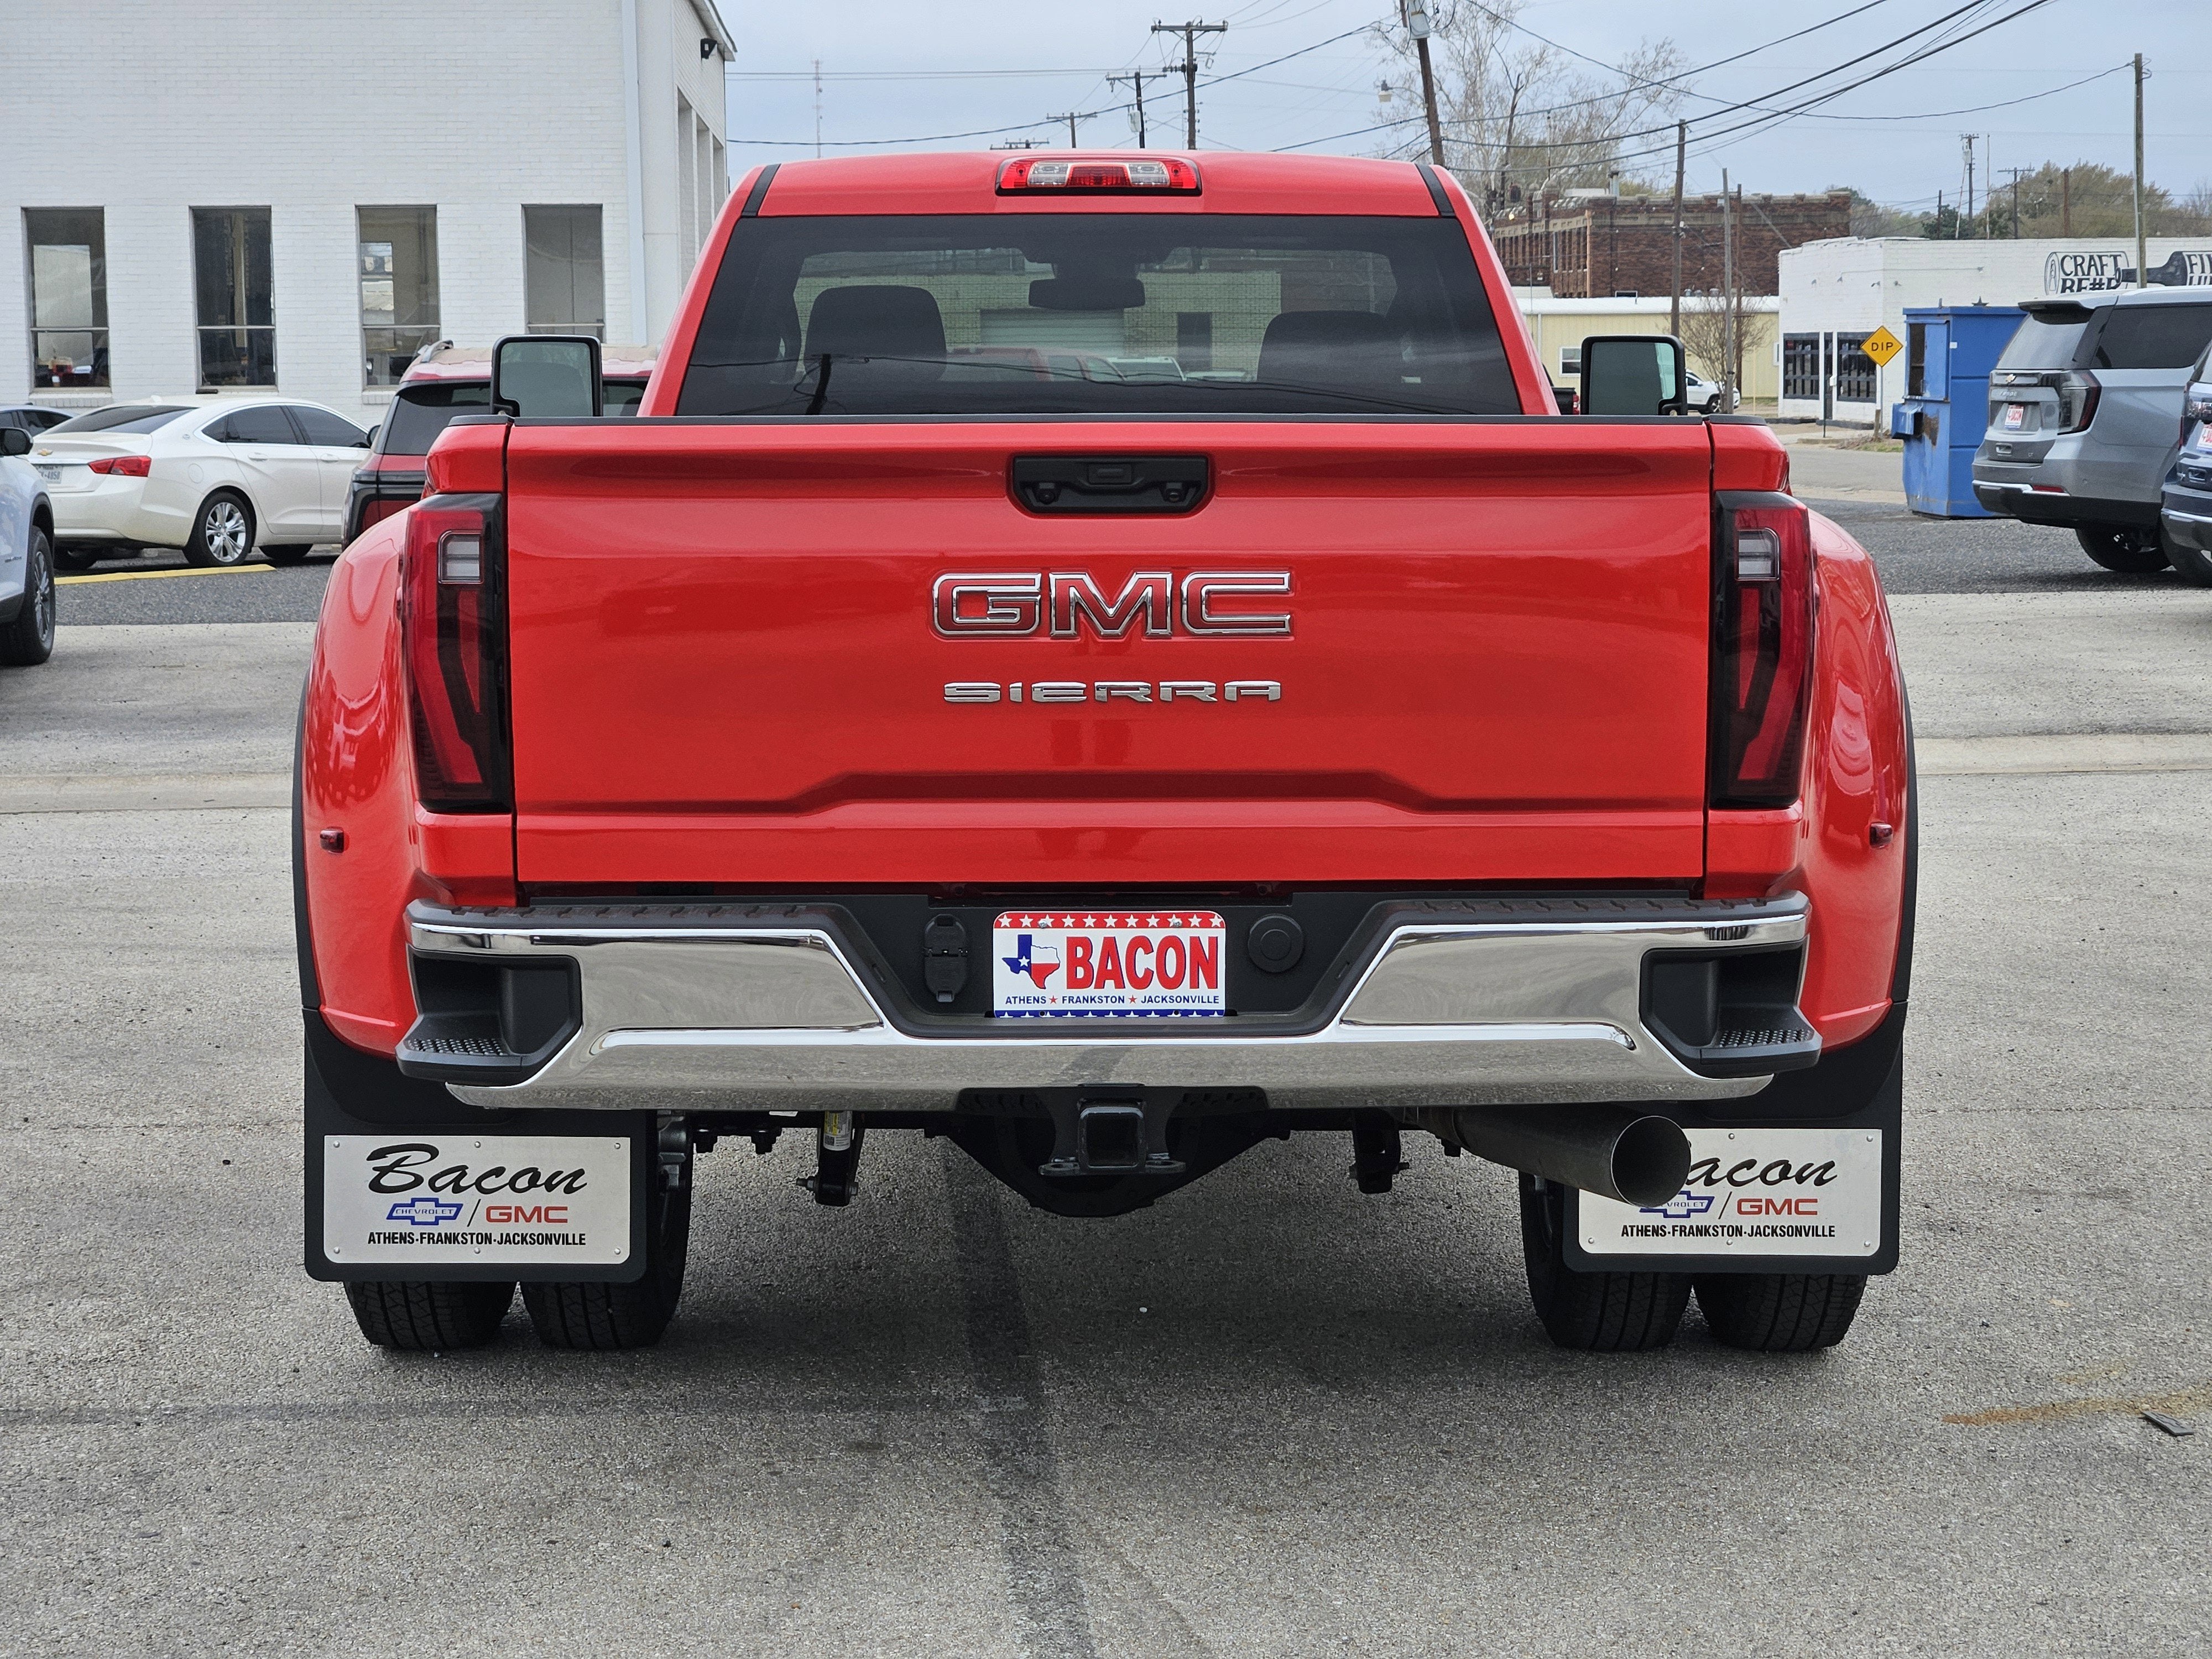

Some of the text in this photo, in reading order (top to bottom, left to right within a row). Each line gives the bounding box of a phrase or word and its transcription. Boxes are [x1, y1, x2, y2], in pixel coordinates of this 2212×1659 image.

[2060, 254, 2122, 276] CRAFT
[1871, 342, 1893, 351] DIP
[932, 572, 1291, 636] GMC
[943, 681, 1281, 703] SIERRA
[1066, 935, 1218, 990] BACON
[1005, 995, 1220, 1005] ATHENS FRANKSTON JACKSONVILLE
[366, 1142, 588, 1195] Bacon
[1685, 1150, 1838, 1188] acon
[486, 1206, 568, 1223] GMC
[1736, 1198, 1818, 1215] GMC
